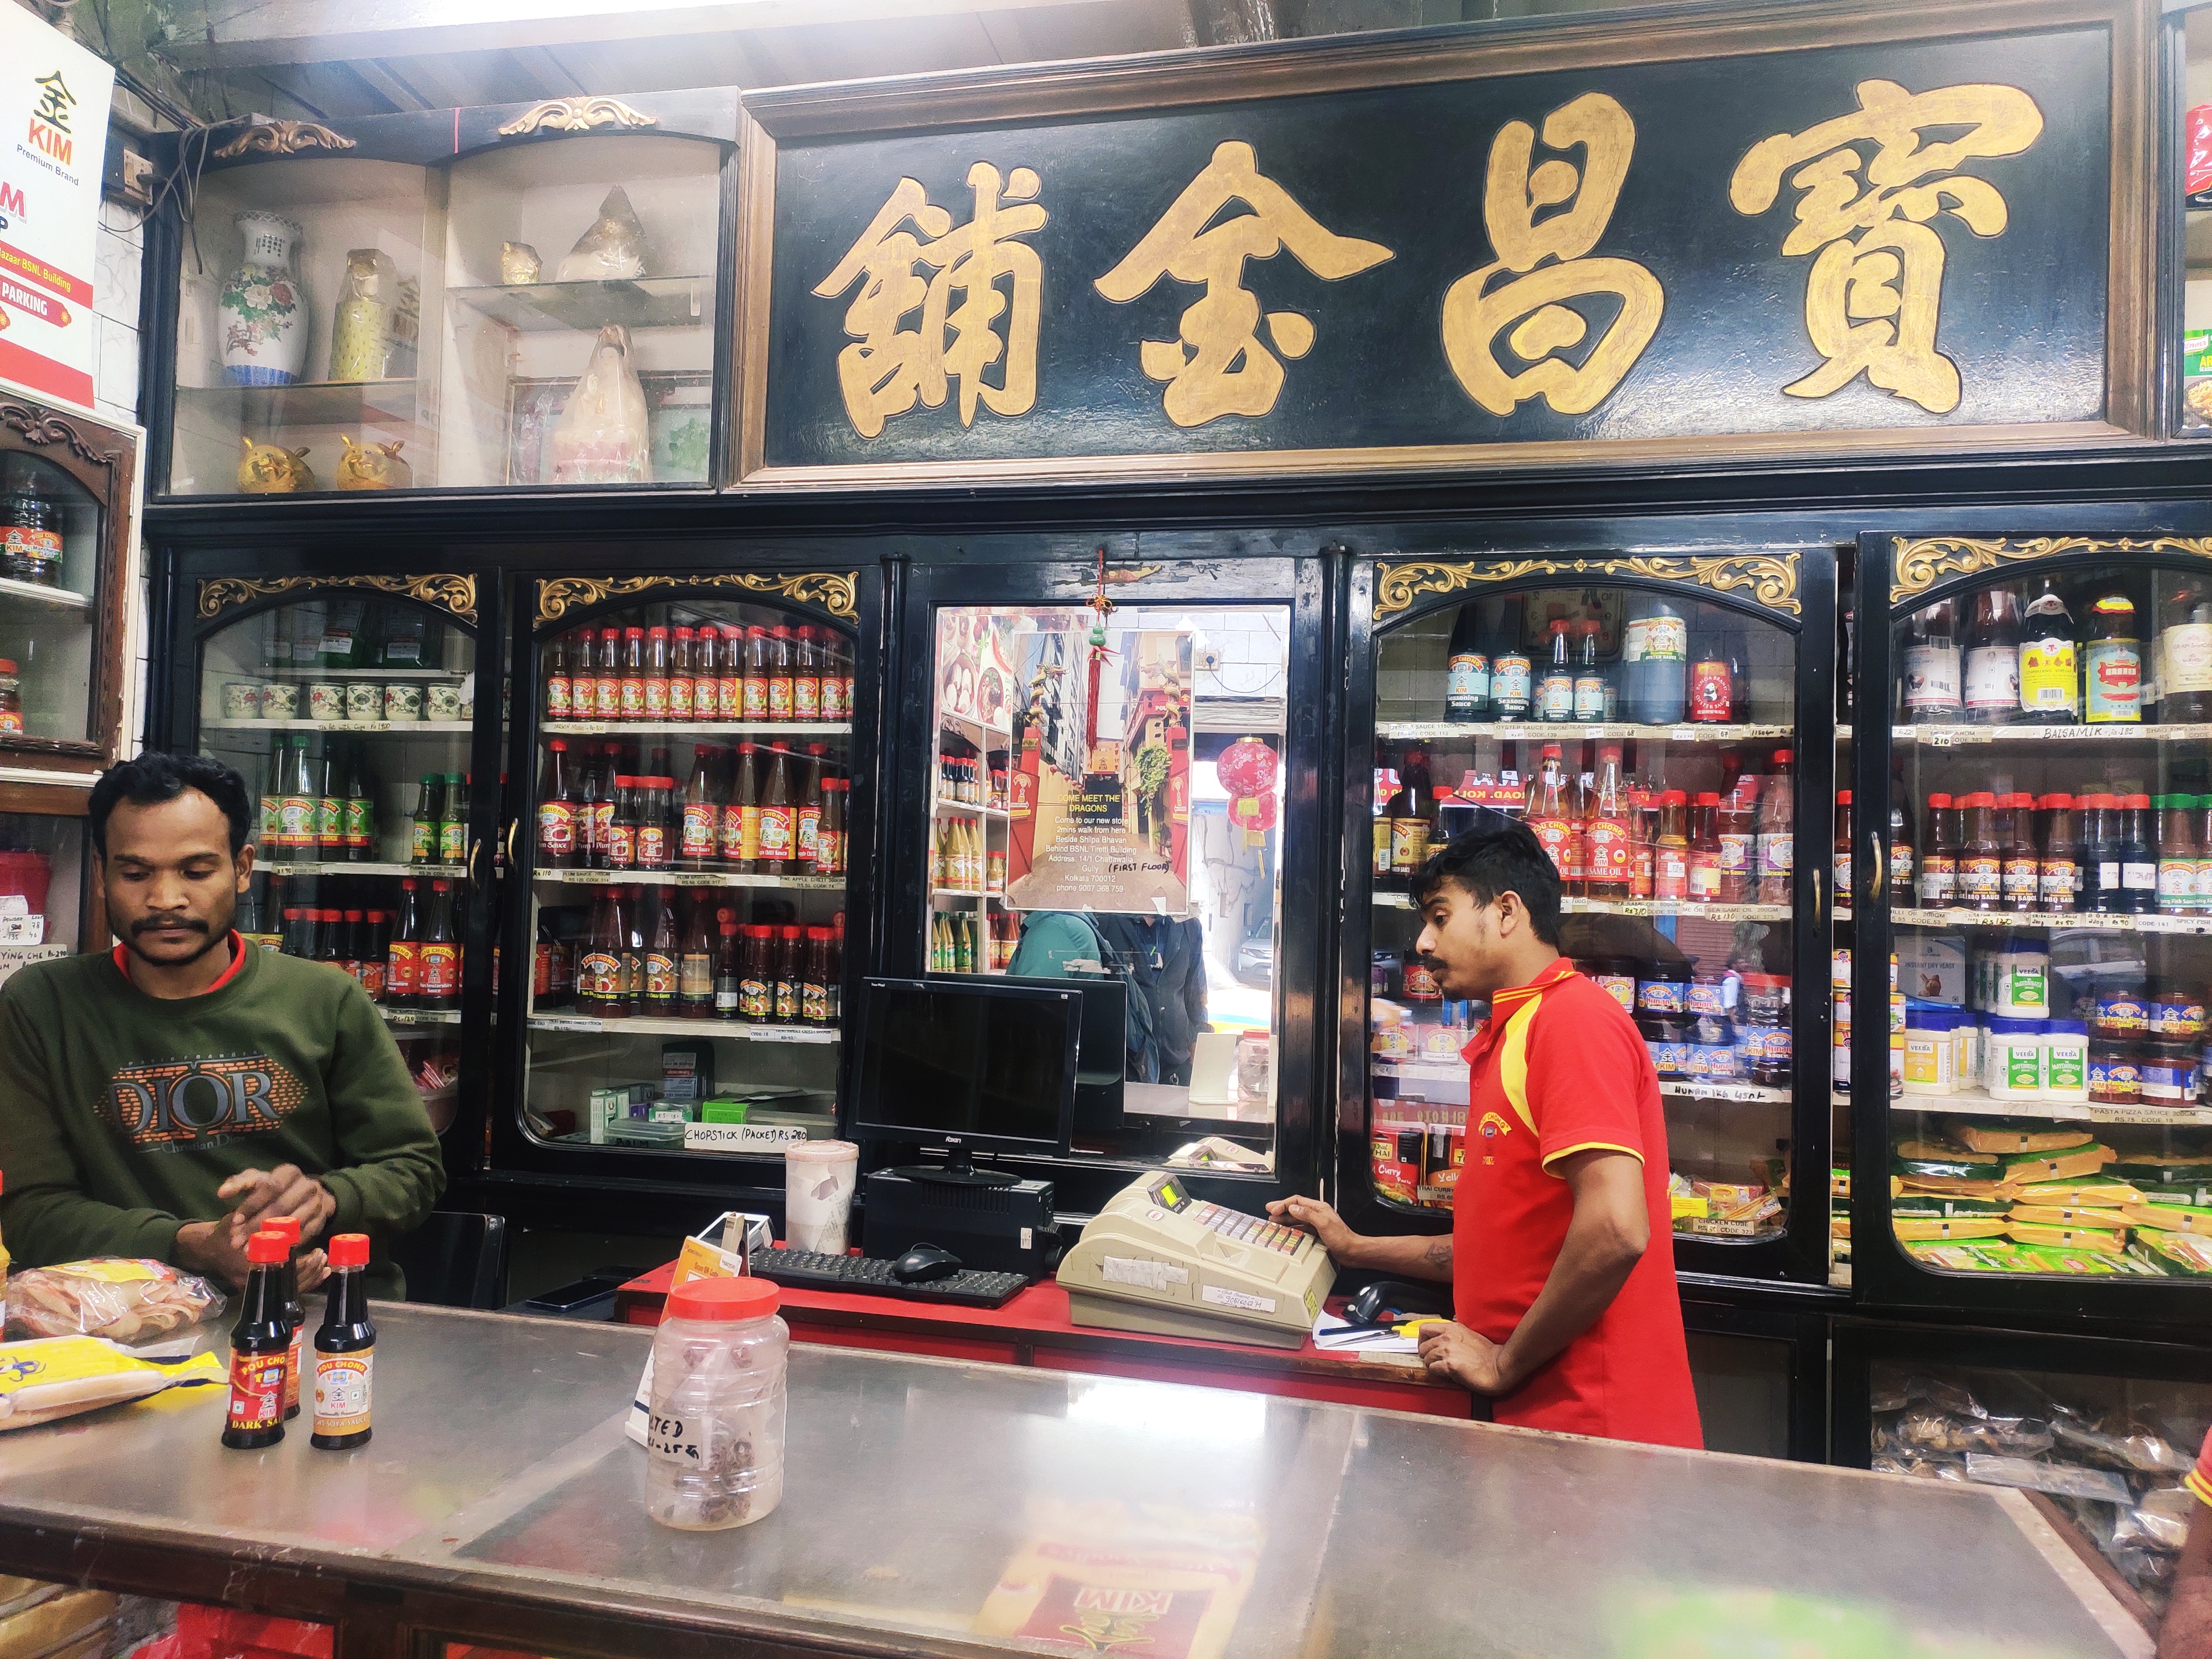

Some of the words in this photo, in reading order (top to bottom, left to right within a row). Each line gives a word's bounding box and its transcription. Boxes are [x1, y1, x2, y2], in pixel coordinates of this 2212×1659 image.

[28, 117, 72, 165] KIM
[17, 144, 53, 171] Premium
[55, 165, 79, 186] Brand
[0, 248, 20, 266] azaar
[22, 258, 41, 276] BSNL
[43, 269, 71, 293] Building
[2, 281, 48, 316] PARKING
[1459, 656, 1480, 667] CHONG
[1498, 660, 1510, 670] POU
[1510, 679, 1521, 690] 金
[1695, 676, 1712, 690] PANDA
[1498, 698, 1529, 706] Seasoning
[1934, 737, 1949, 745] 210
[1534, 824, 1547, 834] POU
[1548, 822, 1571, 834] CHONG
[1597, 823, 1623, 836] CHONG
[1079, 836, 1100, 844] Shilpa
[1110, 846, 1137, 855] Building
[1082, 865, 1099, 873] Gully
[1108, 863, 1138, 873] (FIRST
[1141, 862, 1170, 874] FLOOR)
[431, 948, 453, 958] CHONG
[597, 955, 616, 966] CHONG
[649, 956, 669, 966] CHONG
[1688, 999, 1712, 1008] Hunan
[1748, 1047, 1763, 1056] KIM
[1675, 1086, 1708, 1095] HUNAN
[109, 1072, 280, 1134] DIOR
[1487, 1113, 1506, 1128] CHONG
[685, 1129, 737, 1140] CHOPSTICK
[742, 1127, 776, 1143] (PACKET)
[779, 1131, 789, 1140] RS
[791, 1129, 806, 1140] 280
[161, 1139, 214, 1154] Christian
[1378, 1164, 1401, 1176] Curry
[242, 1359, 264, 1376] POU
[319, 1363, 333, 1372] POU
[335, 1361, 365, 1371] CHONG
[332, 1387, 346, 1401] 金
[259, 1408, 275, 1417] KIM
[232, 1420, 262, 1430] DARK
[347, 1417, 367, 1426] SAUCE
